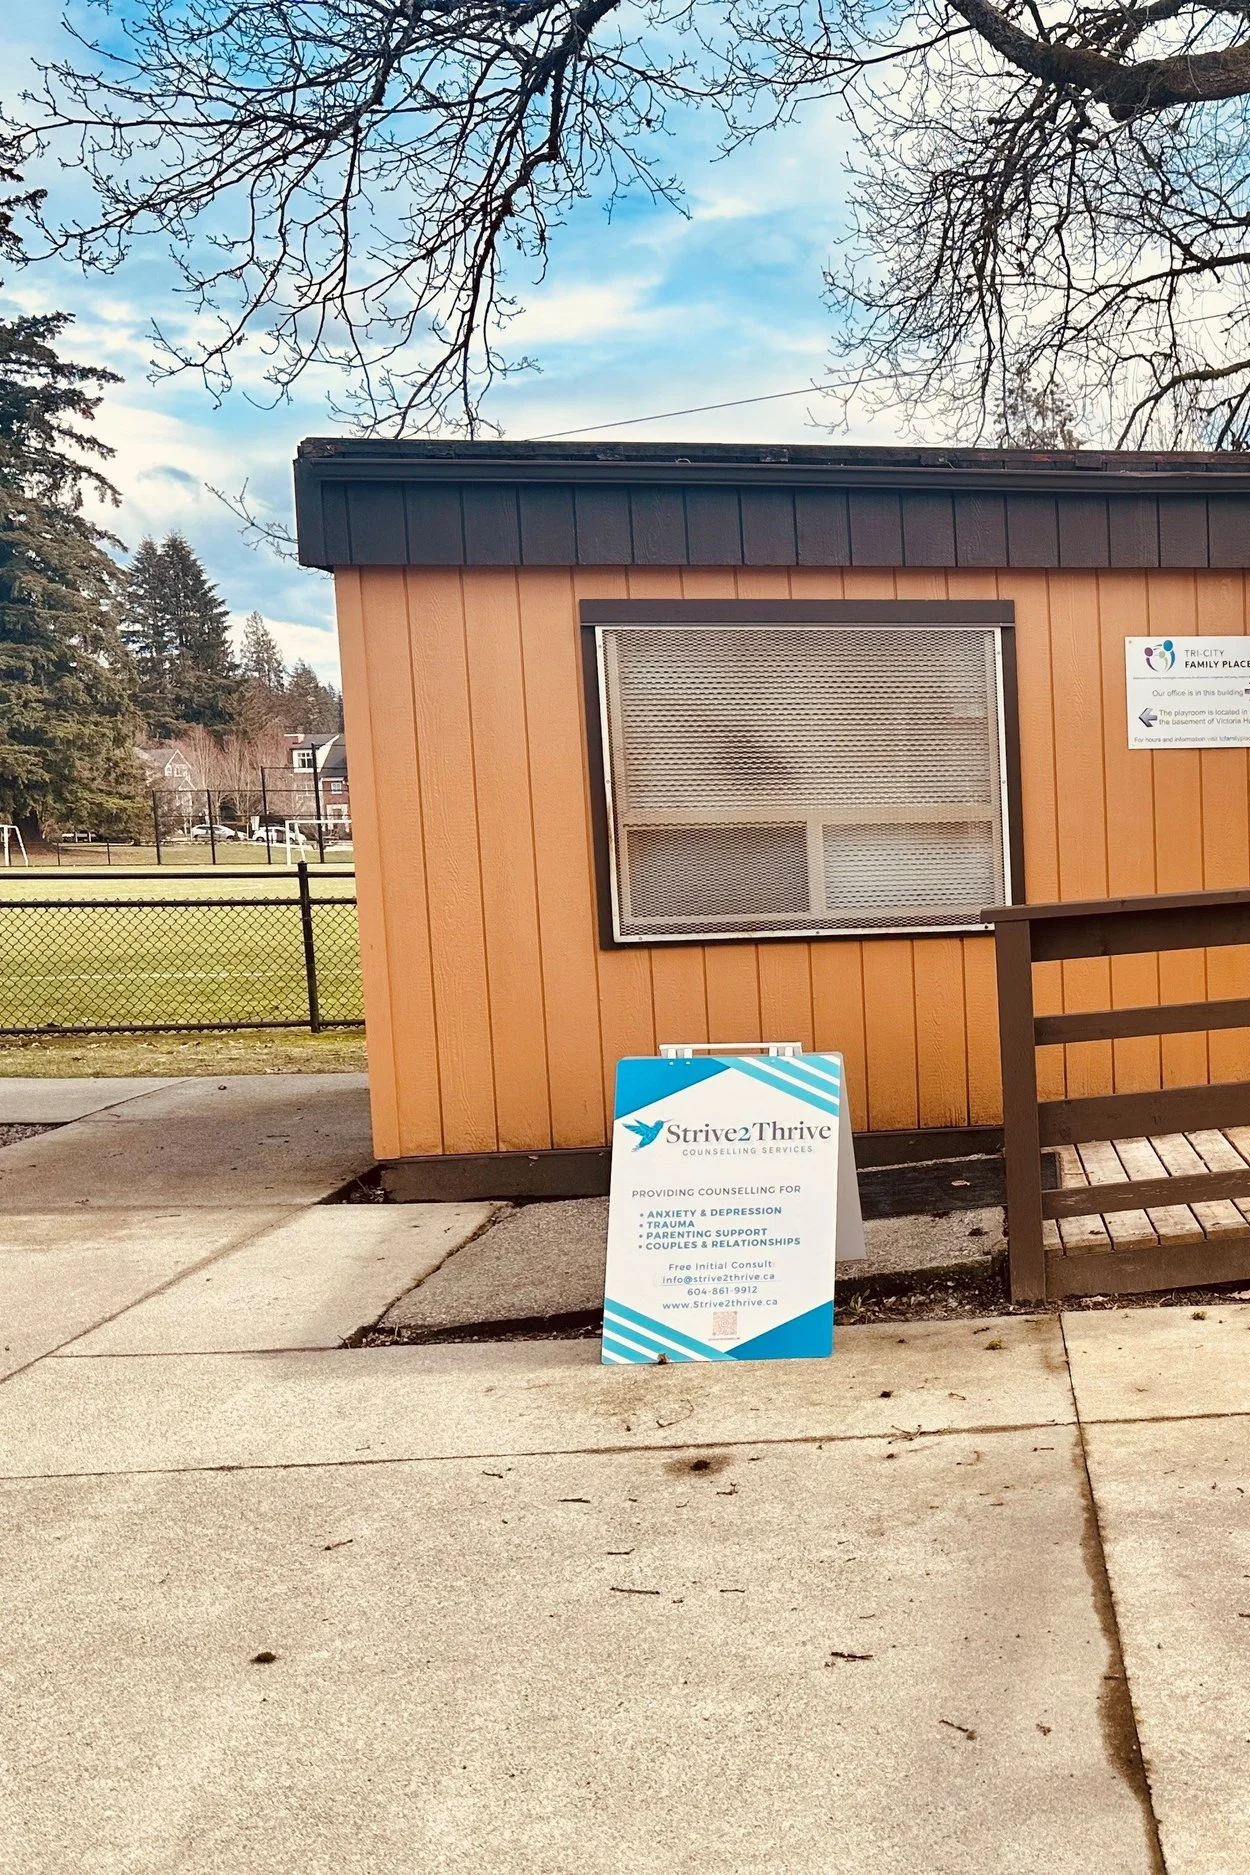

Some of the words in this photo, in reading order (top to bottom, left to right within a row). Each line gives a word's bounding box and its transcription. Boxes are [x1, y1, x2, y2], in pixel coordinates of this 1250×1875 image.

[1184, 649, 1225, 657] TRI-CITY
[1184, 660, 1220, 669] FAMILY
[1152, 689, 1165, 697] Our
[1167, 689, 1186, 697] office
[1217, 689, 1244, 698] building
[1174, 709, 1206, 718] playroom
[1215, 708, 1240, 716] located
[1207, 717, 1214, 725] of
[1175, 735, 1206, 743] information
[666, 1120, 832, 1145] Strive2Thrive
[682, 1147, 757, 1157] COUNSELLING
[762, 1145, 813, 1154] SERVICES
[631, 1188, 695, 1198] PROVIDING
[698, 1186, 776, 1197] COUNSELLING
[779, 1185, 802, 1195] FOR
[647, 1209, 697, 1219] ANXIETY
[700, 1208, 707, 1217] &
[710, 1206, 783, 1217] DEPRESSION
[646, 1220, 695, 1229] TRAUMA
[646, 1230, 712, 1240] PARENTING
[715, 1228, 768, 1238] SUPPORT
[645, 1241, 698, 1251] COUPLES
[701, 1240, 708, 1249] &
[711, 1237, 801, 1249] RELATIONSHIPS
[668, 1263, 692, 1271] Free
[695, 1262, 728, 1270] Initial
[662, 1273, 775, 1284] info@strive2thrive.ca
[687, 1285, 758, 1296] 604-861-9912
[662, 1298, 778, 1310] www.Strive2thrive.ca
